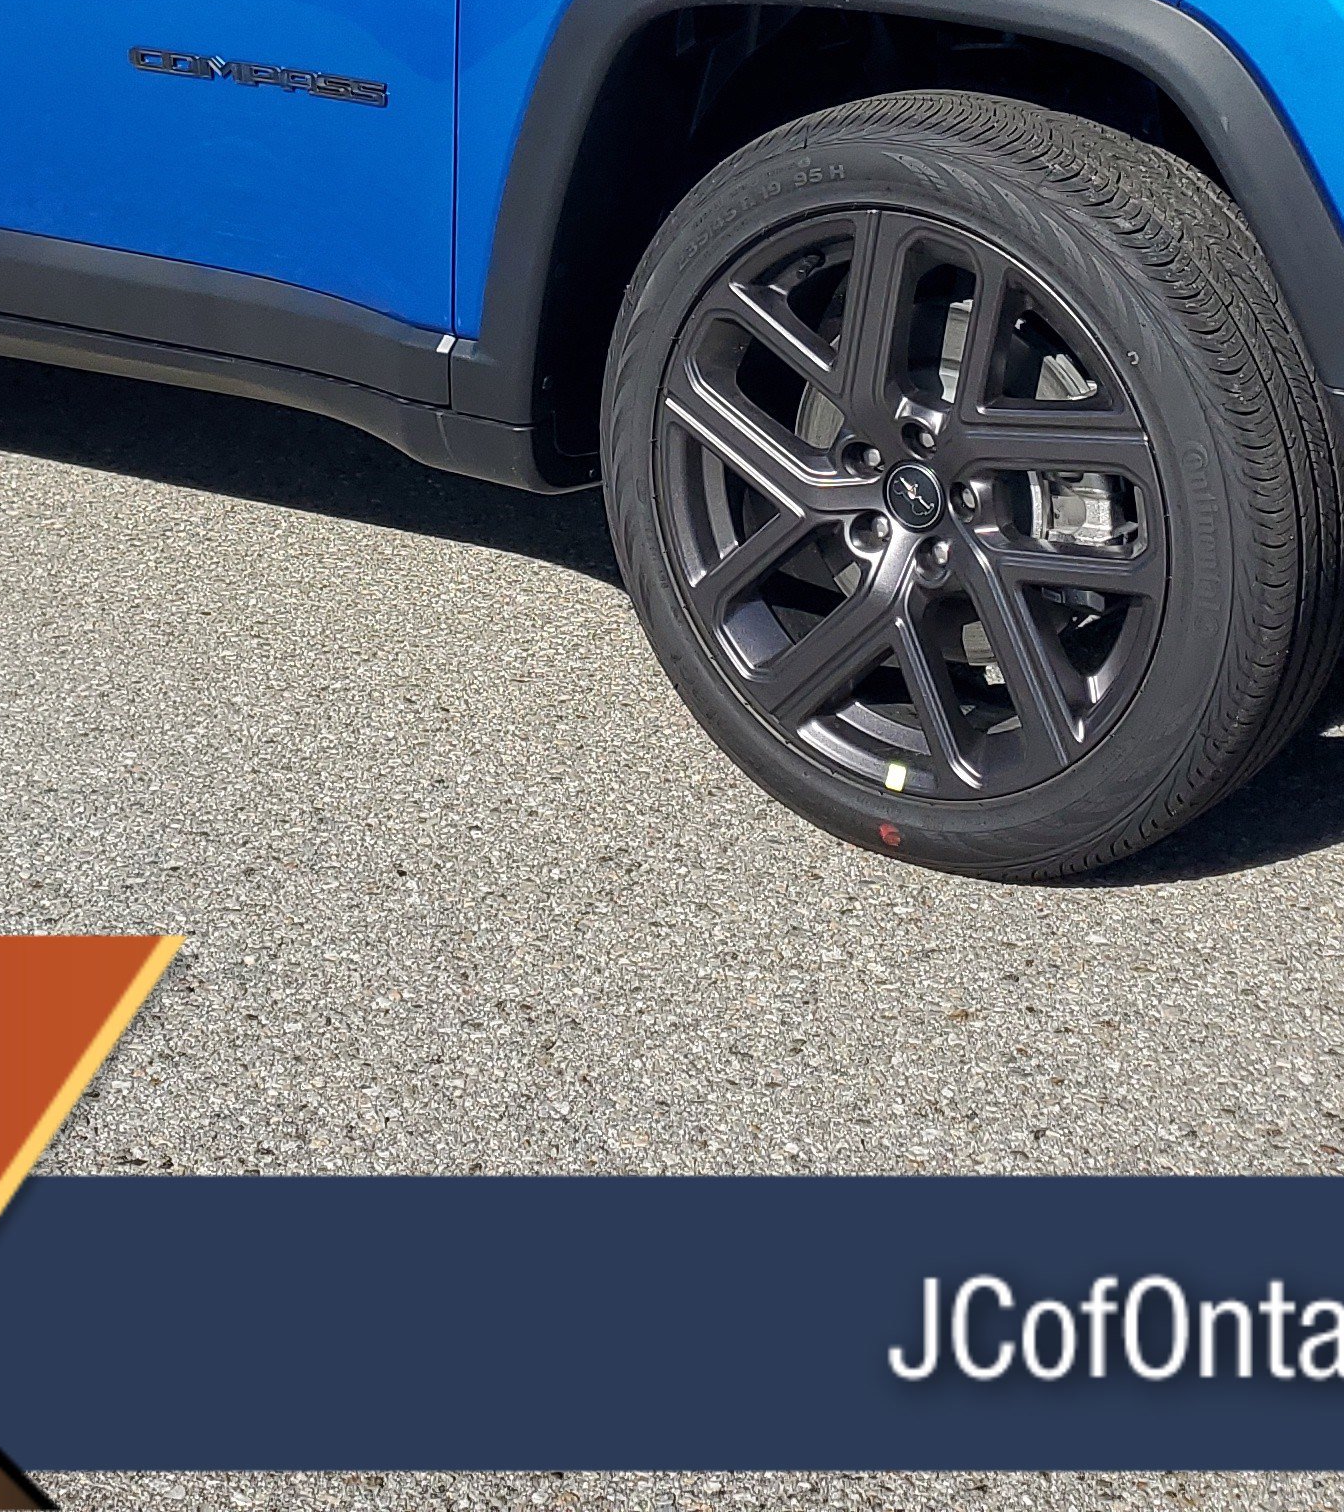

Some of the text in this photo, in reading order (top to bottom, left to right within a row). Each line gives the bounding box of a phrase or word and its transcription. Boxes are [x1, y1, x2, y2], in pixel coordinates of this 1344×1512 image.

[128, 45, 389, 108] COMPASS
[793, 167, 824, 188] 95
[828, 164, 846, 180] H
